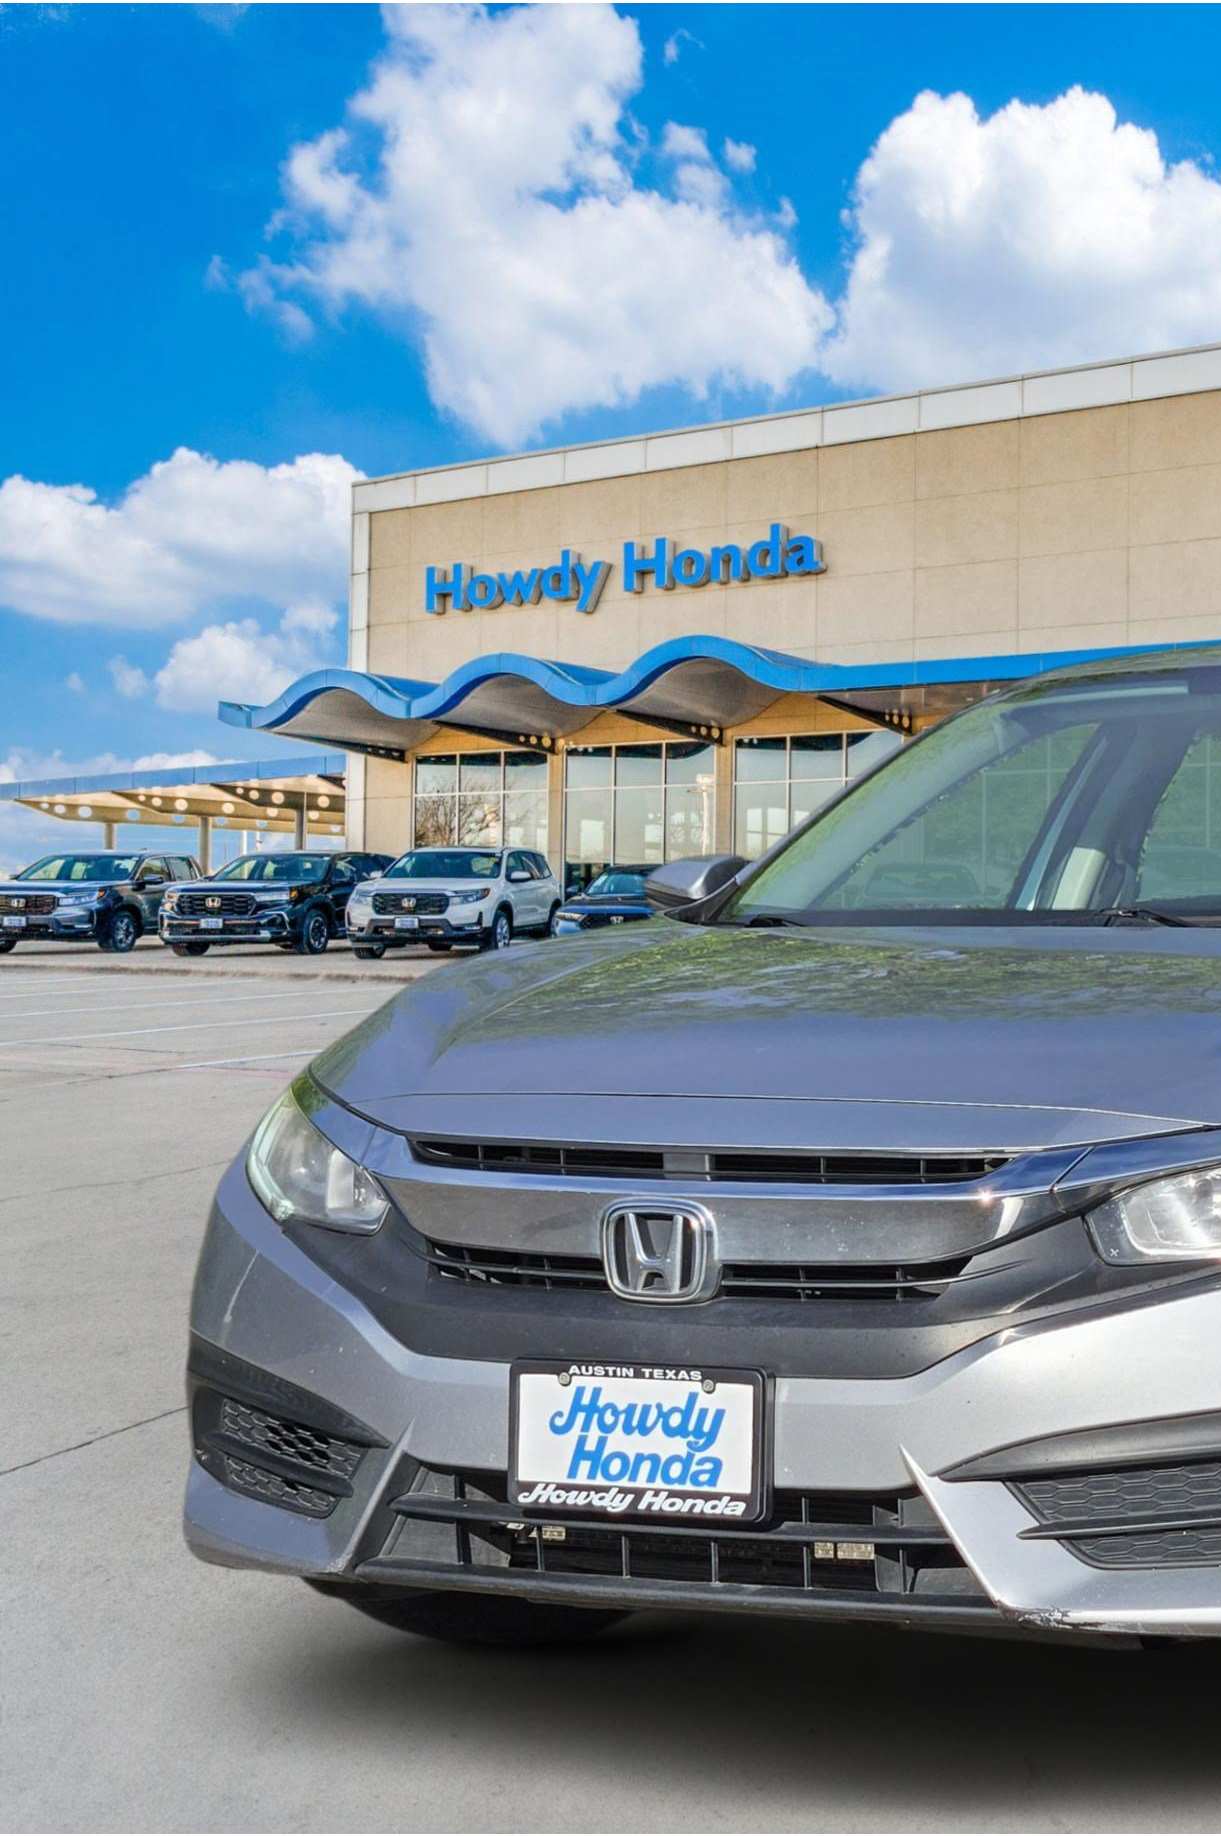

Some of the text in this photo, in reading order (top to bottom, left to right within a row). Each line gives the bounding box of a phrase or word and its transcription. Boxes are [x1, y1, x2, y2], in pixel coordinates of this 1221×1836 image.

[425, 523, 822, 614] Howdy Honda
[568, 1364, 703, 1381] AUSTIN TEXAS
[548, 1385, 726, 1453] Howdy
[566, 1434, 723, 1488] Honda
[517, 1483, 747, 1517] Howdy Honda
